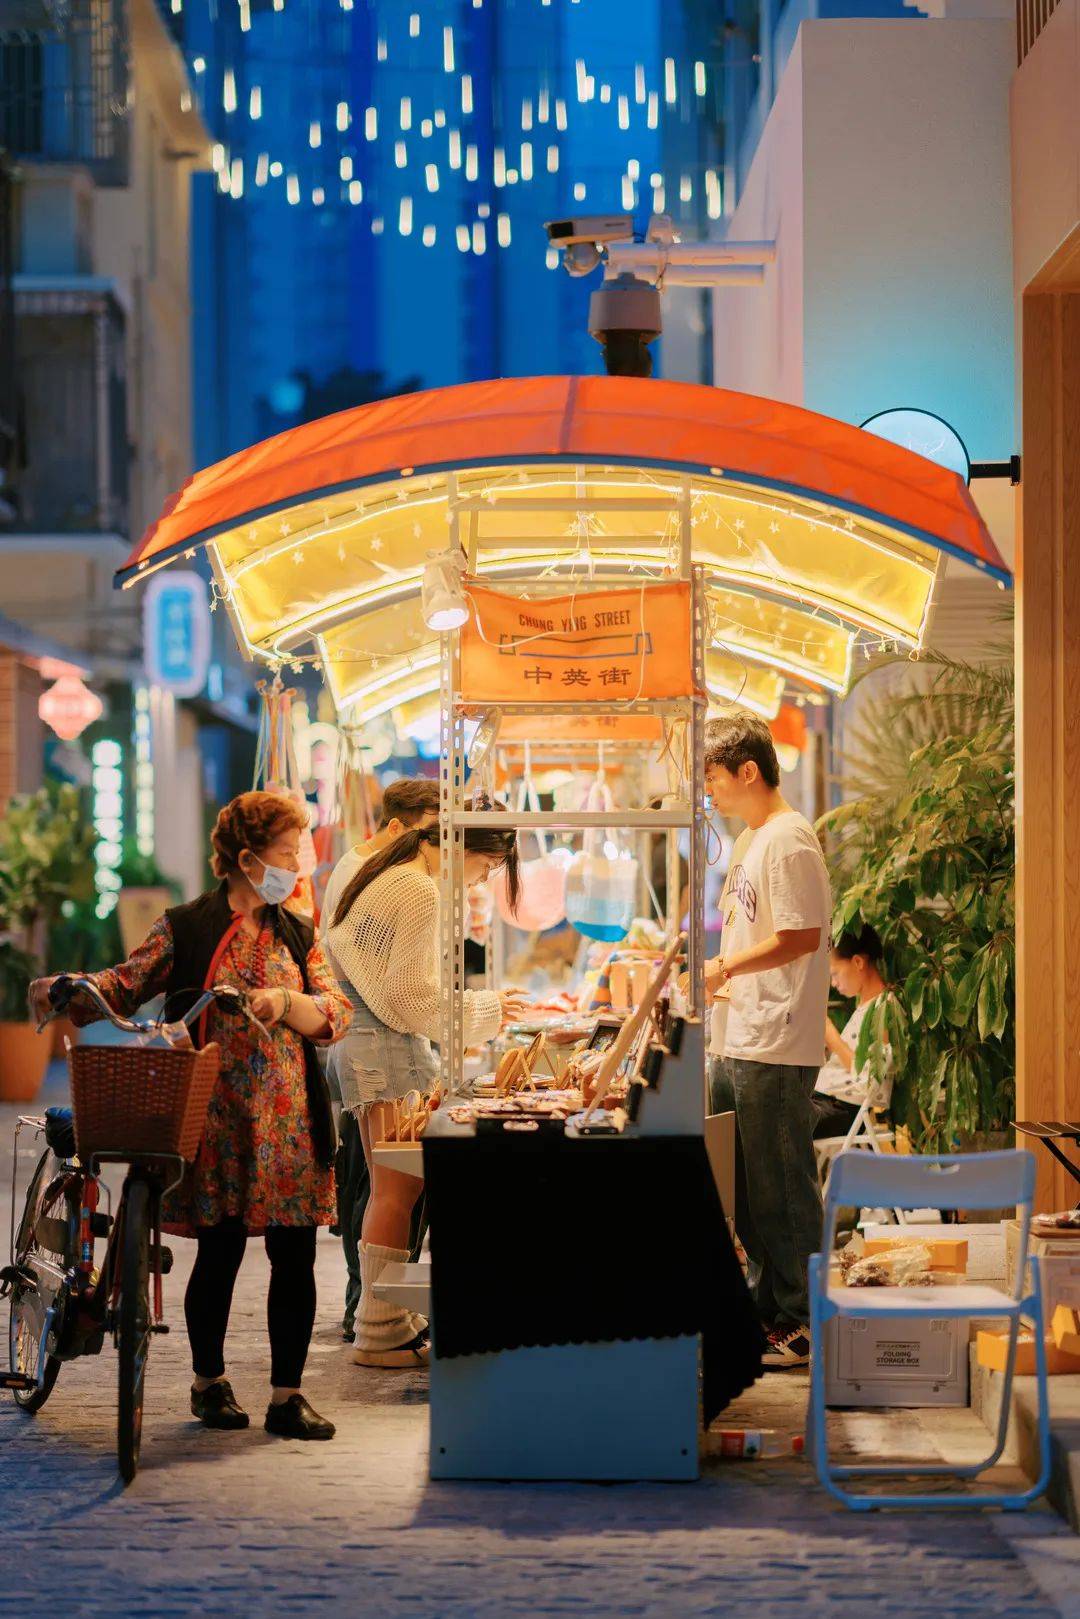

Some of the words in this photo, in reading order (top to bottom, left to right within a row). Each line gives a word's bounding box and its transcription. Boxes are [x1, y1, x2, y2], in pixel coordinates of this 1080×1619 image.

[519, 614, 554, 632] CHUNG
[594, 610, 631, 628] STREET
[523, 665, 632, 687] 中英街
